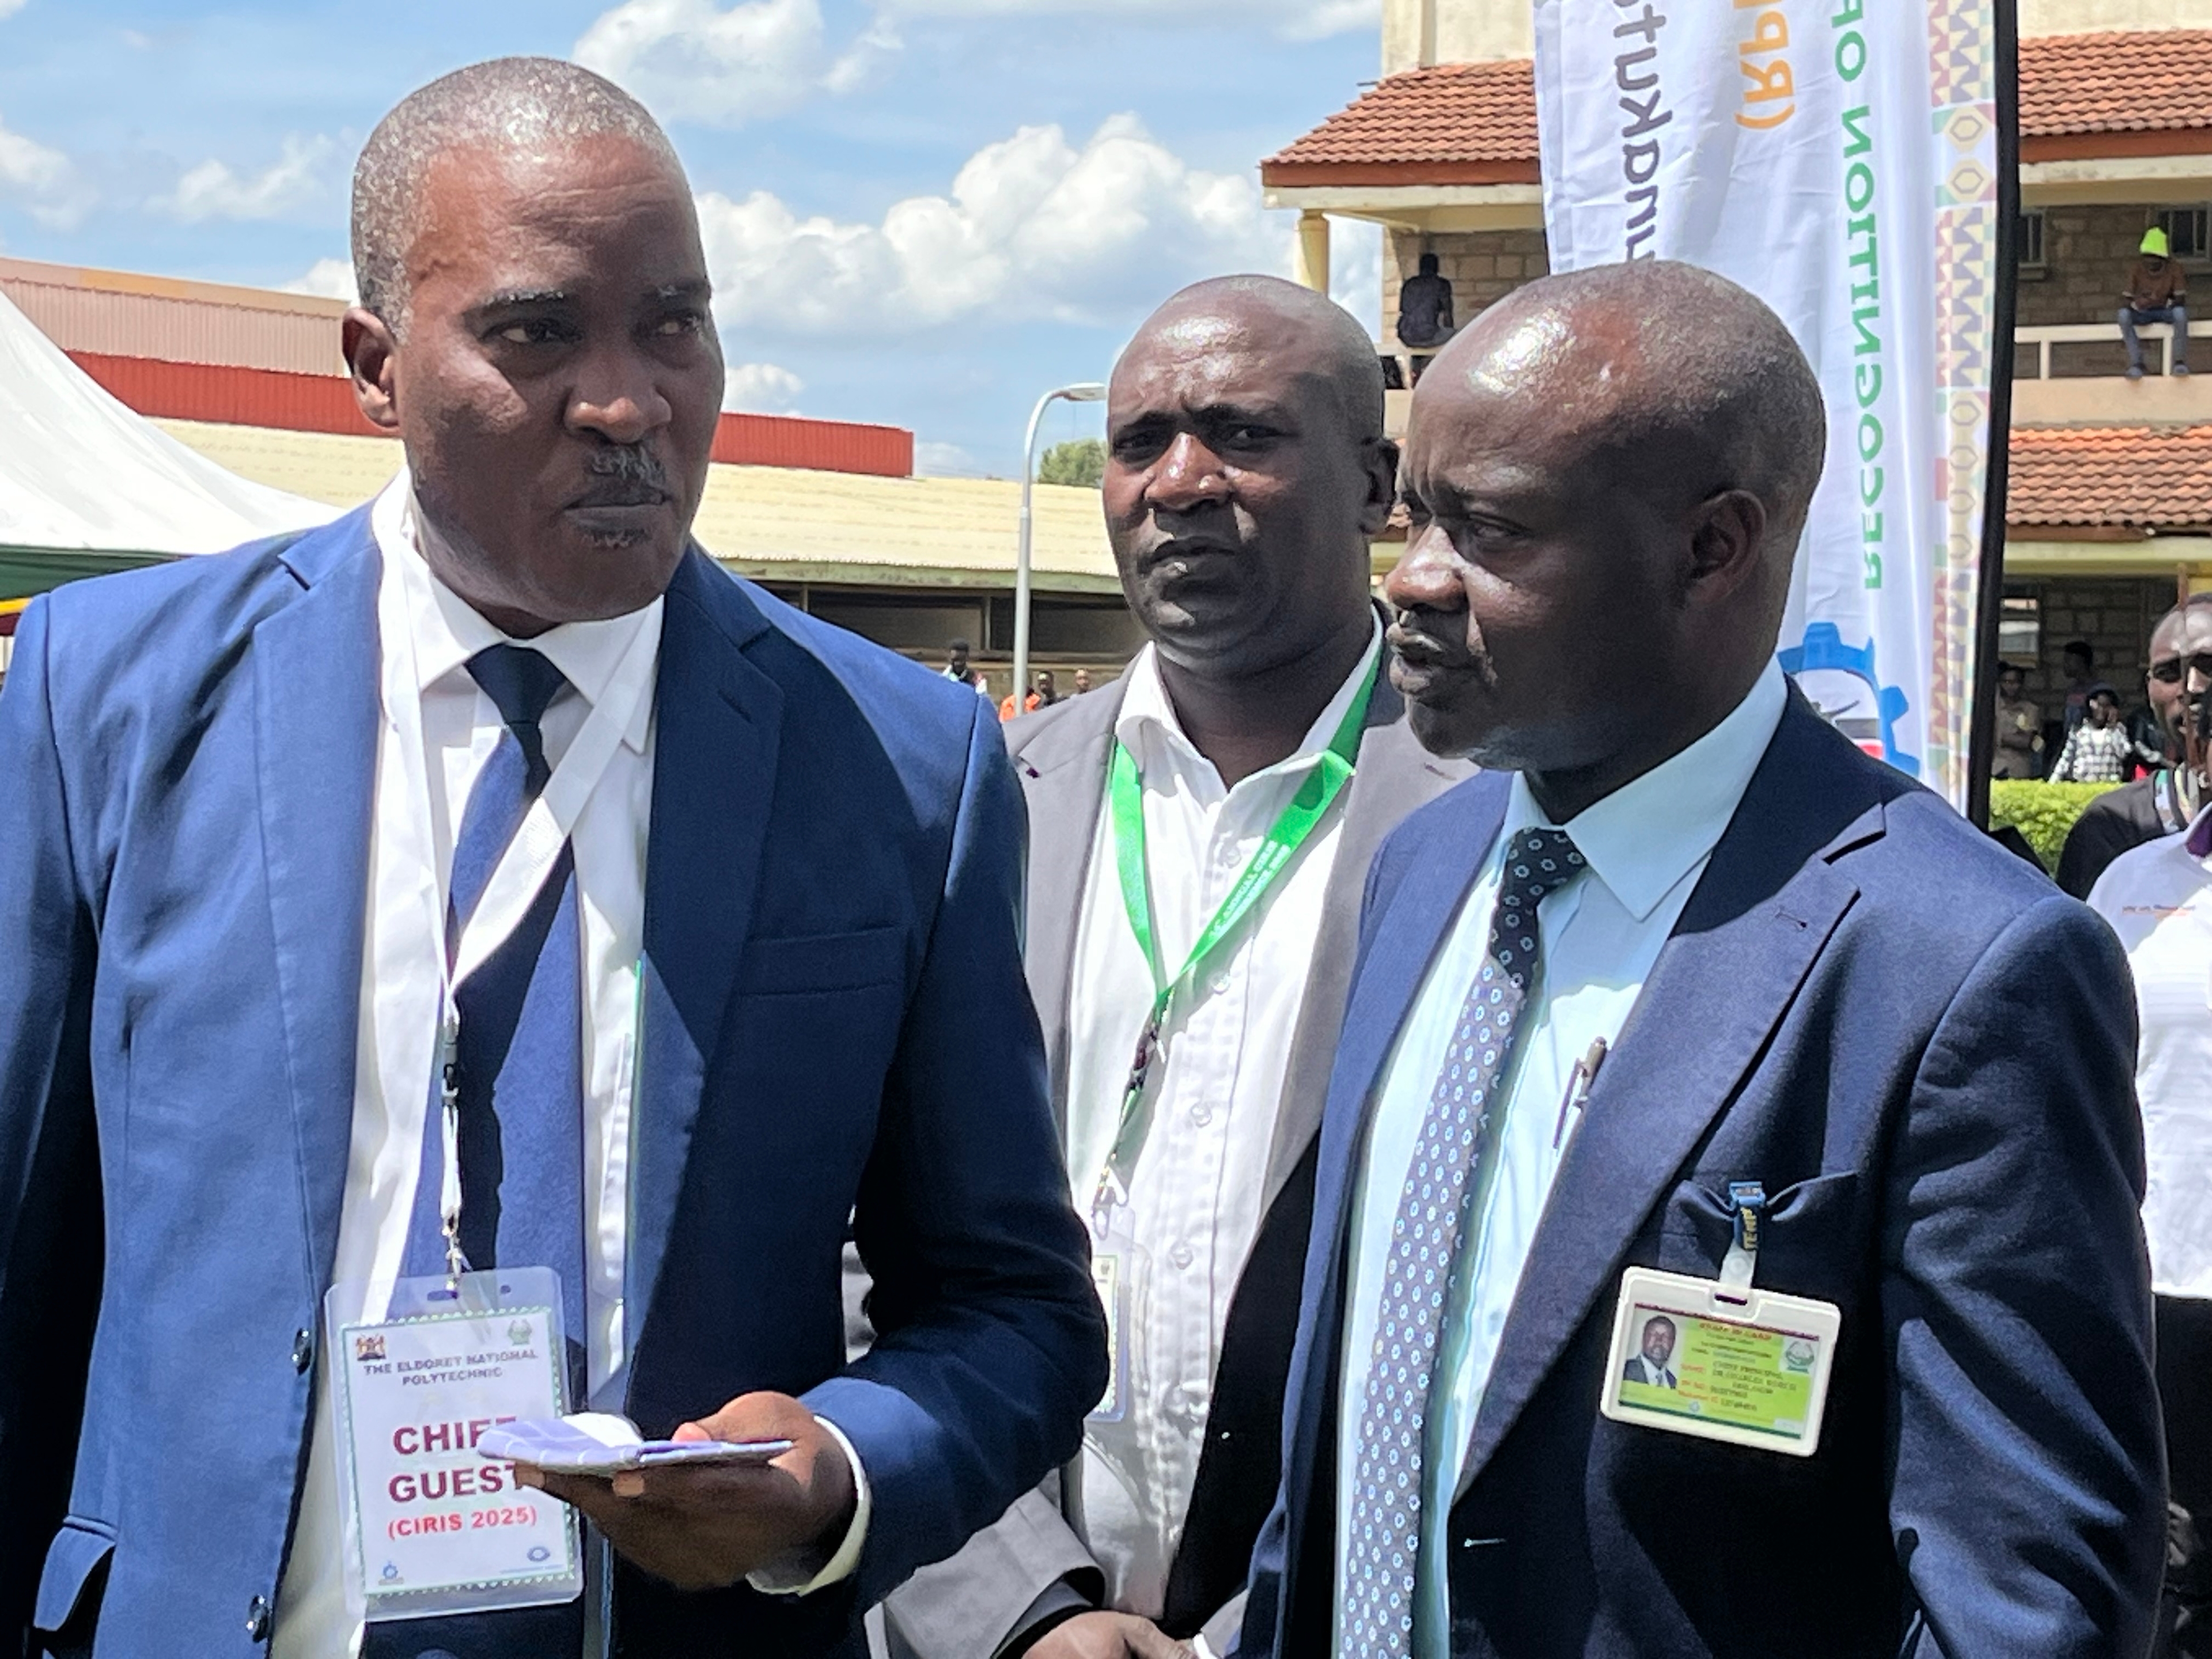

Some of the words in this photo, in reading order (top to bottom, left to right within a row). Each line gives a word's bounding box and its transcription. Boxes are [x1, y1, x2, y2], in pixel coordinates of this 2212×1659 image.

[363, 1363, 392, 1376] THE
[397, 1355, 462, 1373] ELDORET
[466, 1349, 539, 1365] NATIONAL
[402, 1367, 503, 1385] POLYTECHNIC
[392, 1416, 517, 1456] CHIE
[387, 1513, 463, 1541] (CIRIS
[471, 1505, 537, 1529] 2025)
